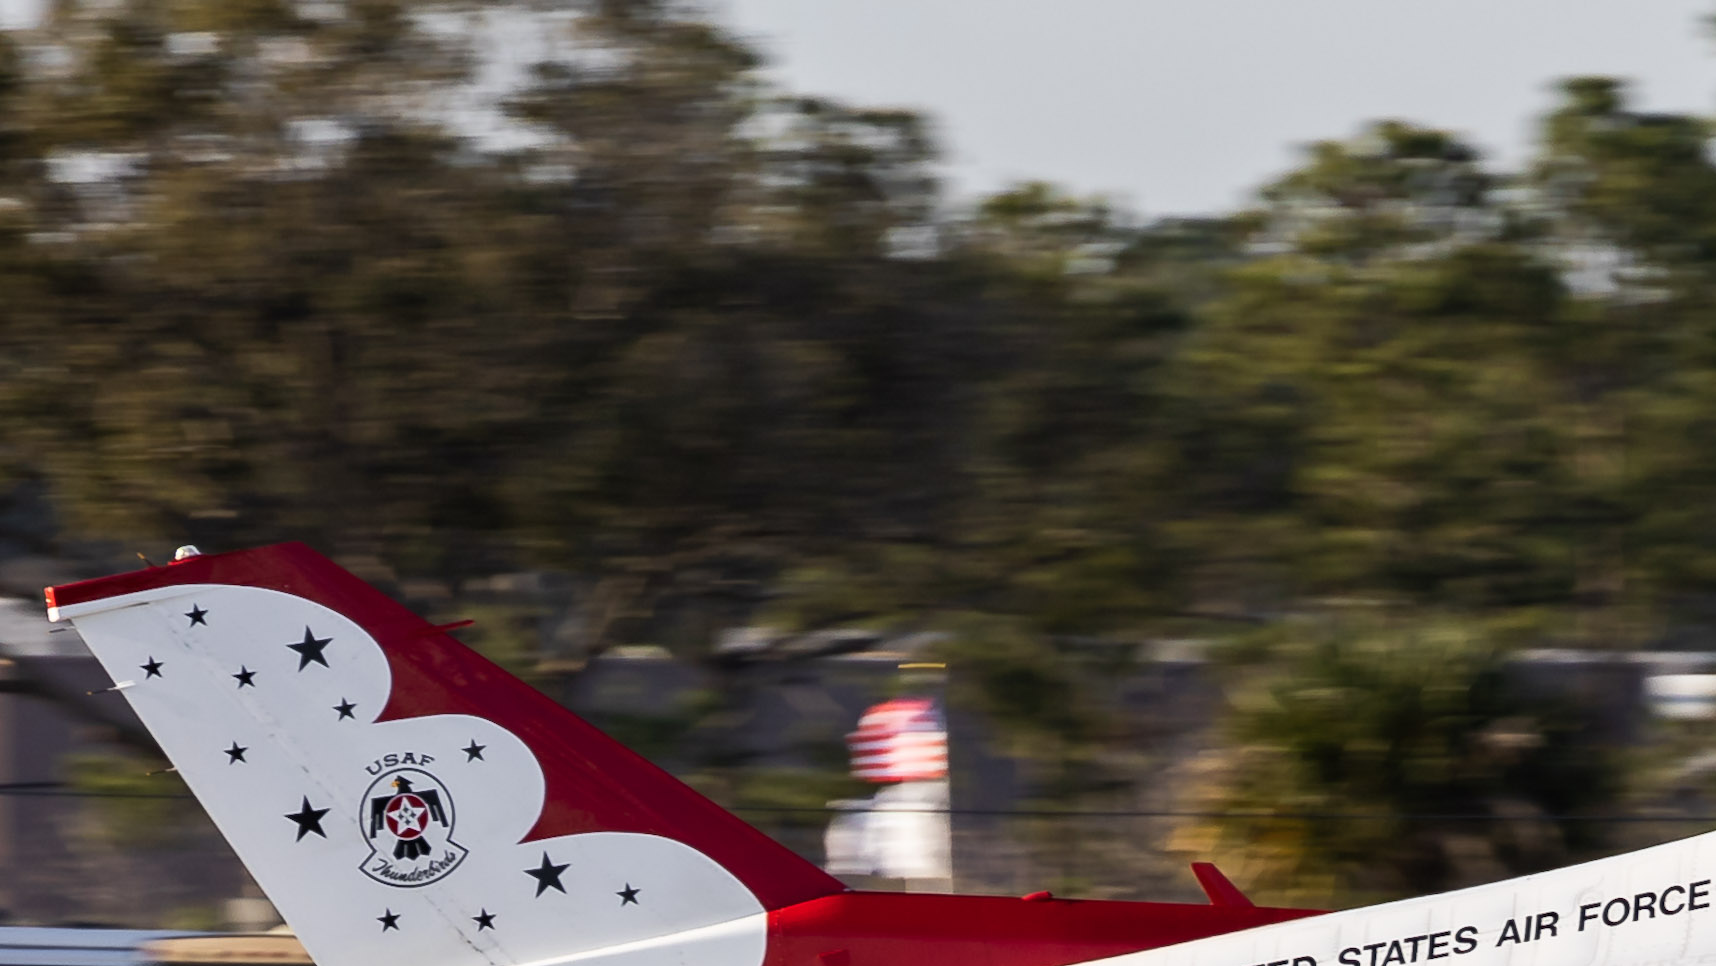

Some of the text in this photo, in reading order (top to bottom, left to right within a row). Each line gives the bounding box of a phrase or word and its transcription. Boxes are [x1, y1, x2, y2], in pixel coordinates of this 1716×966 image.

[365, 752, 436, 776] USAF
[372, 850, 456, 882] Thunderbirds
[1494, 911, 1560, 947] AIR
[1577, 879, 1712, 932] FORCE
